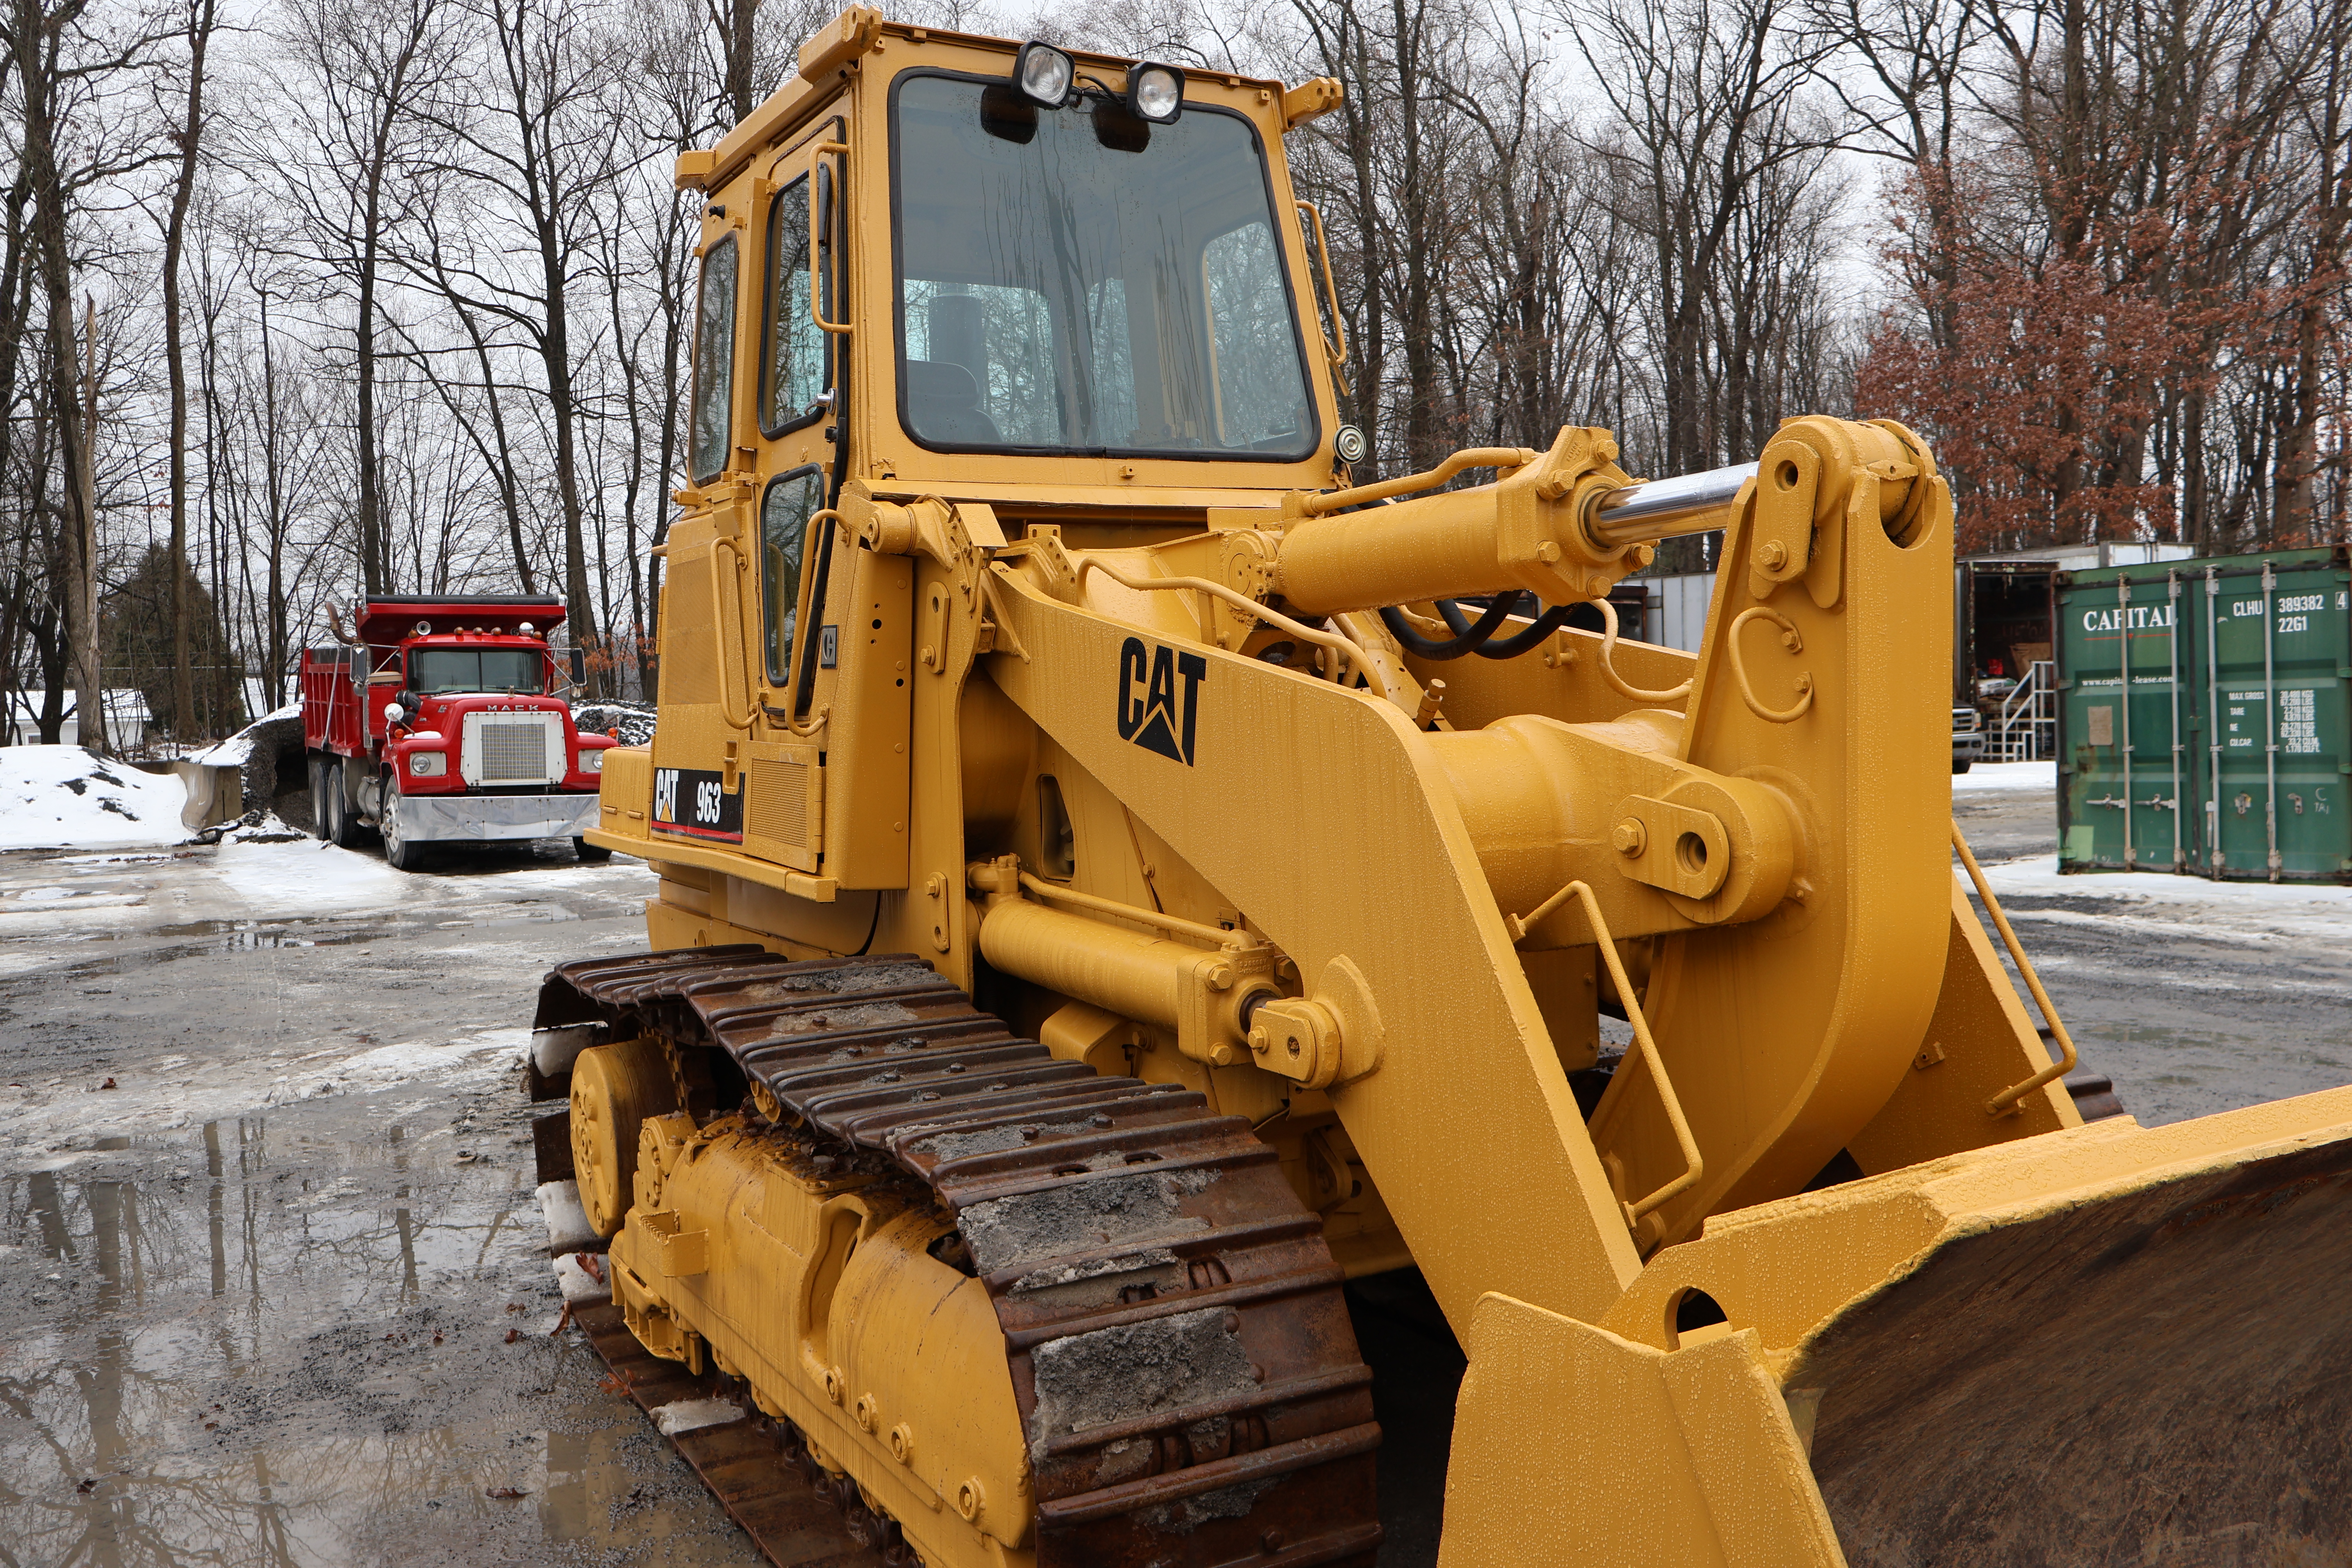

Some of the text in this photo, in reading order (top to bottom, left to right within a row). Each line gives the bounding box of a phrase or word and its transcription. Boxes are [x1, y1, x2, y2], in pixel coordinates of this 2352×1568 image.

[2233, 593, 2347, 617] CLHU 389382 4
[2278, 615, 2307, 633] 22G1
[1118, 637, 1206, 767] CAT
[2229, 692, 2244, 701] MAX
[2245, 691, 2265, 700] GROSS
[2302, 690, 2314, 698] KGS
[2230, 707, 2245, 716] TARE
[2302, 722, 2315, 730] KGS
[655, 769, 722, 823] CAT 963
